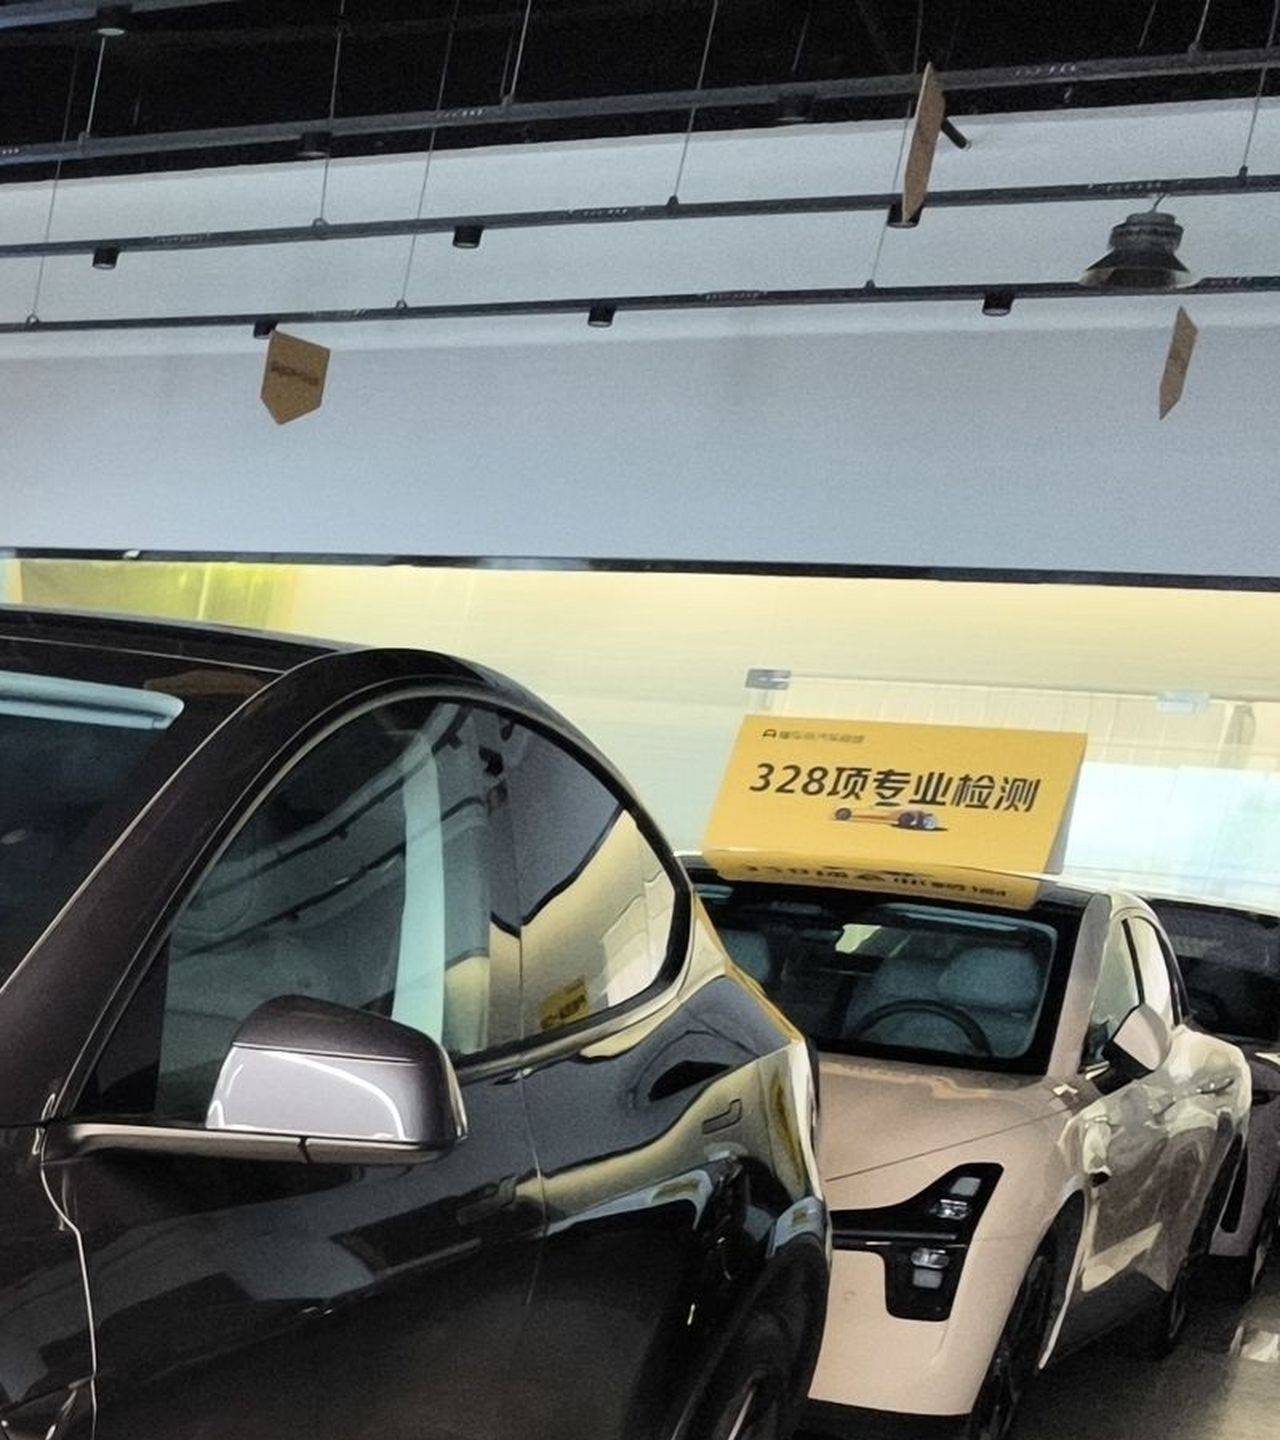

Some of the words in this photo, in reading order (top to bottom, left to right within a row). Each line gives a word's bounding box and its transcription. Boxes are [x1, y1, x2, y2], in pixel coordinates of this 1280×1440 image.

[749, 762, 1041, 813] 328项专业检测
